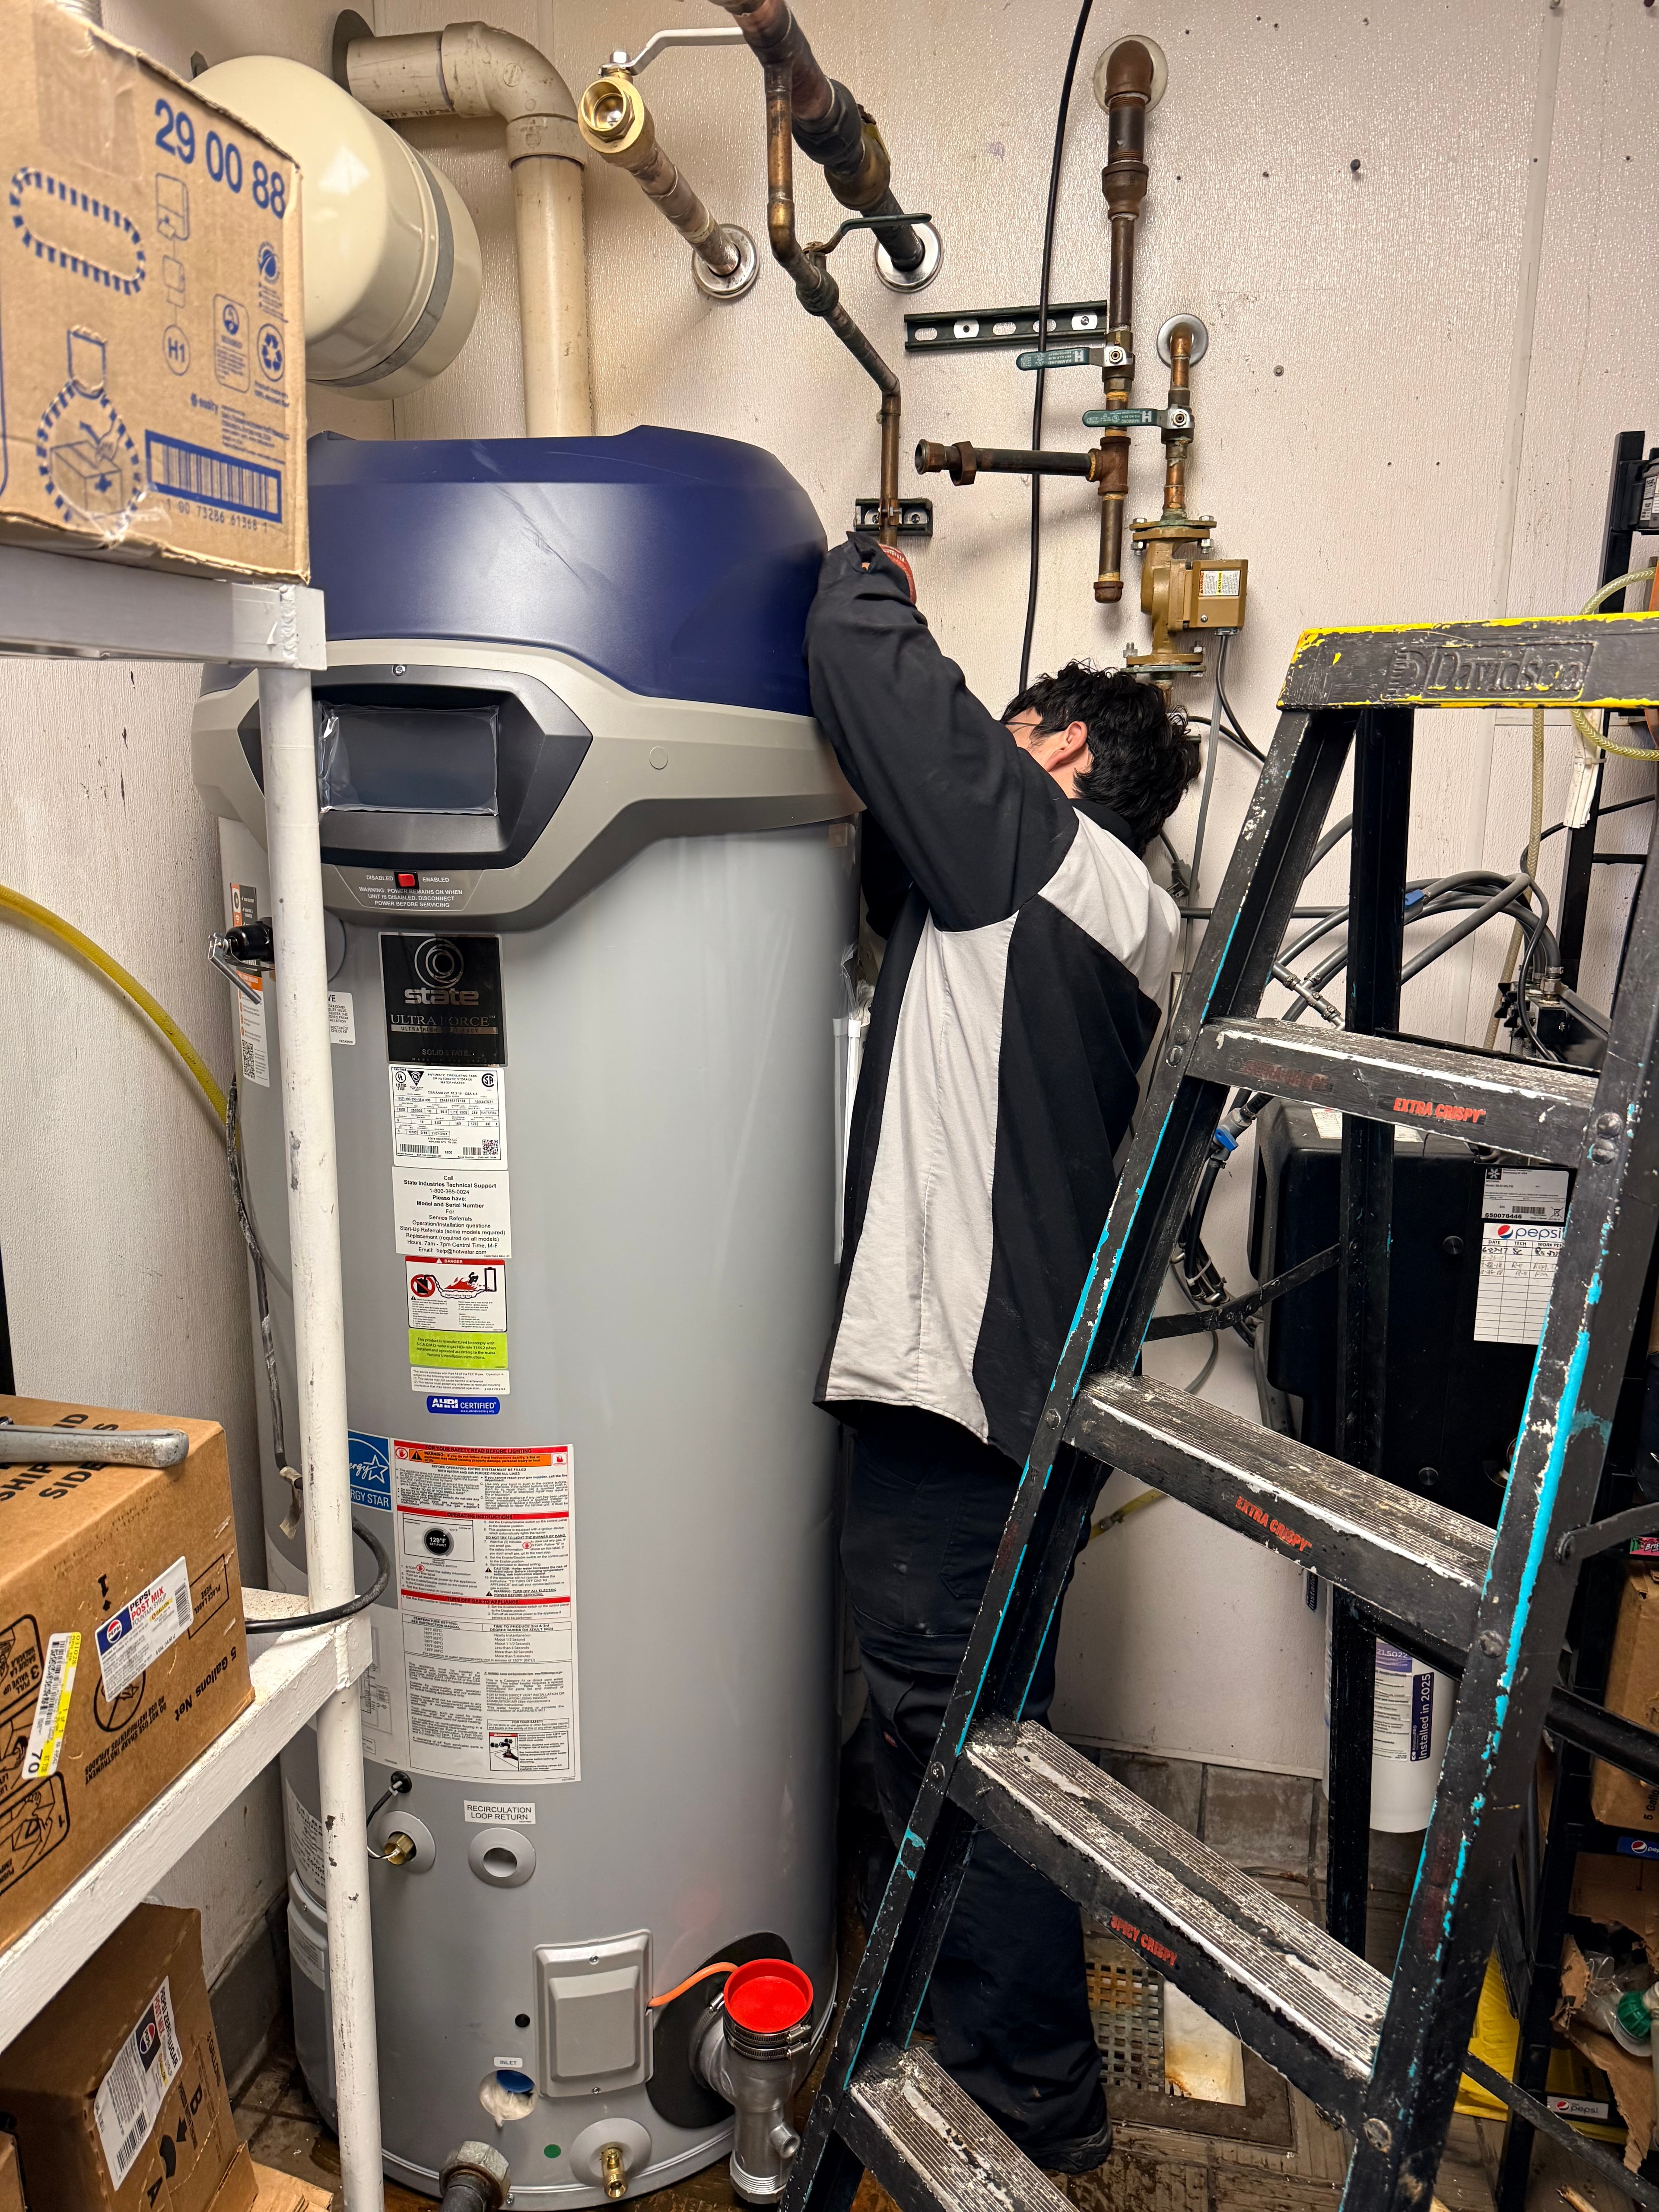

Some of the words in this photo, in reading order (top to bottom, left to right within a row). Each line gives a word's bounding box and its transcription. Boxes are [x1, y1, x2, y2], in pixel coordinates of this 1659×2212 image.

[155, 99, 195, 164] 29
[206, 131, 242, 193] 00
[252, 160, 285, 219] 88
[168, 337, 185, 363] H1
[178, 501, 190, 514] 00
[1427, 647, 1583, 693] Davidson
[404, 987, 479, 1006] state
[391, 1014, 436, 1025] ULTRA
[1393, 1098, 1433, 1116] EXTRA
[1515, 1228, 1561, 1240] pepsi
[432, 1398, 458, 1408] AHRI
[367, 1494, 389, 1507] STAR
[1236, 1496, 1269, 1528] EXTRA
[201, 1583, 212, 1599] HERE
[207, 1584, 220, 1602] PLACE
[130, 1589, 150, 1611] PEPSI
[131, 1599, 149, 1621] POST
[151, 1586, 164, 1603] MIX
[156, 1601, 169, 1615] GALLON
[194, 1598, 207, 1615] LABEL
[132, 1605, 153, 1627] FOUNTAIN
[153, 1593, 166, 1608] SYRUP
[108, 1624, 121, 1638] PEPSI
[231, 1646, 236, 1661] 5
[10, 1667, 18, 1678] LA
[12, 1672, 29, 1685] VALVE
[31, 1665, 39, 1680] 3
[195, 1656, 228, 1697] Gallons
[3, 1685, 11, 1695] UP
[16, 1680, 30, 1694] PULL
[1421, 1673, 1430, 1702] 2025
[149, 1702, 157, 1715] USE
[158, 1695, 164, 1706] NO
[160, 1702, 166, 1714] DO
[175, 1695, 192, 1722] Net
[1420, 1704, 1429, 1714] in
[149, 1711, 159, 1724] NOT
[111, 1711, 147, 1751] INSTRUMENTOS
[139, 1721, 148, 1735] USE
[121, 1730, 138, 1751] SHARP
[1419, 1716, 1429, 1759] Installed
[28, 1749, 43, 1773] 70
[85, 1746, 110, 1775] AFILADOS
[85, 1748, 120, 1785] INSTRUMENT
[467, 1805, 531, 1813] RECIRCULATION
[1111, 1914, 1140, 1942] SPICY
[1141, 1933, 1177, 1967] CRISPY
